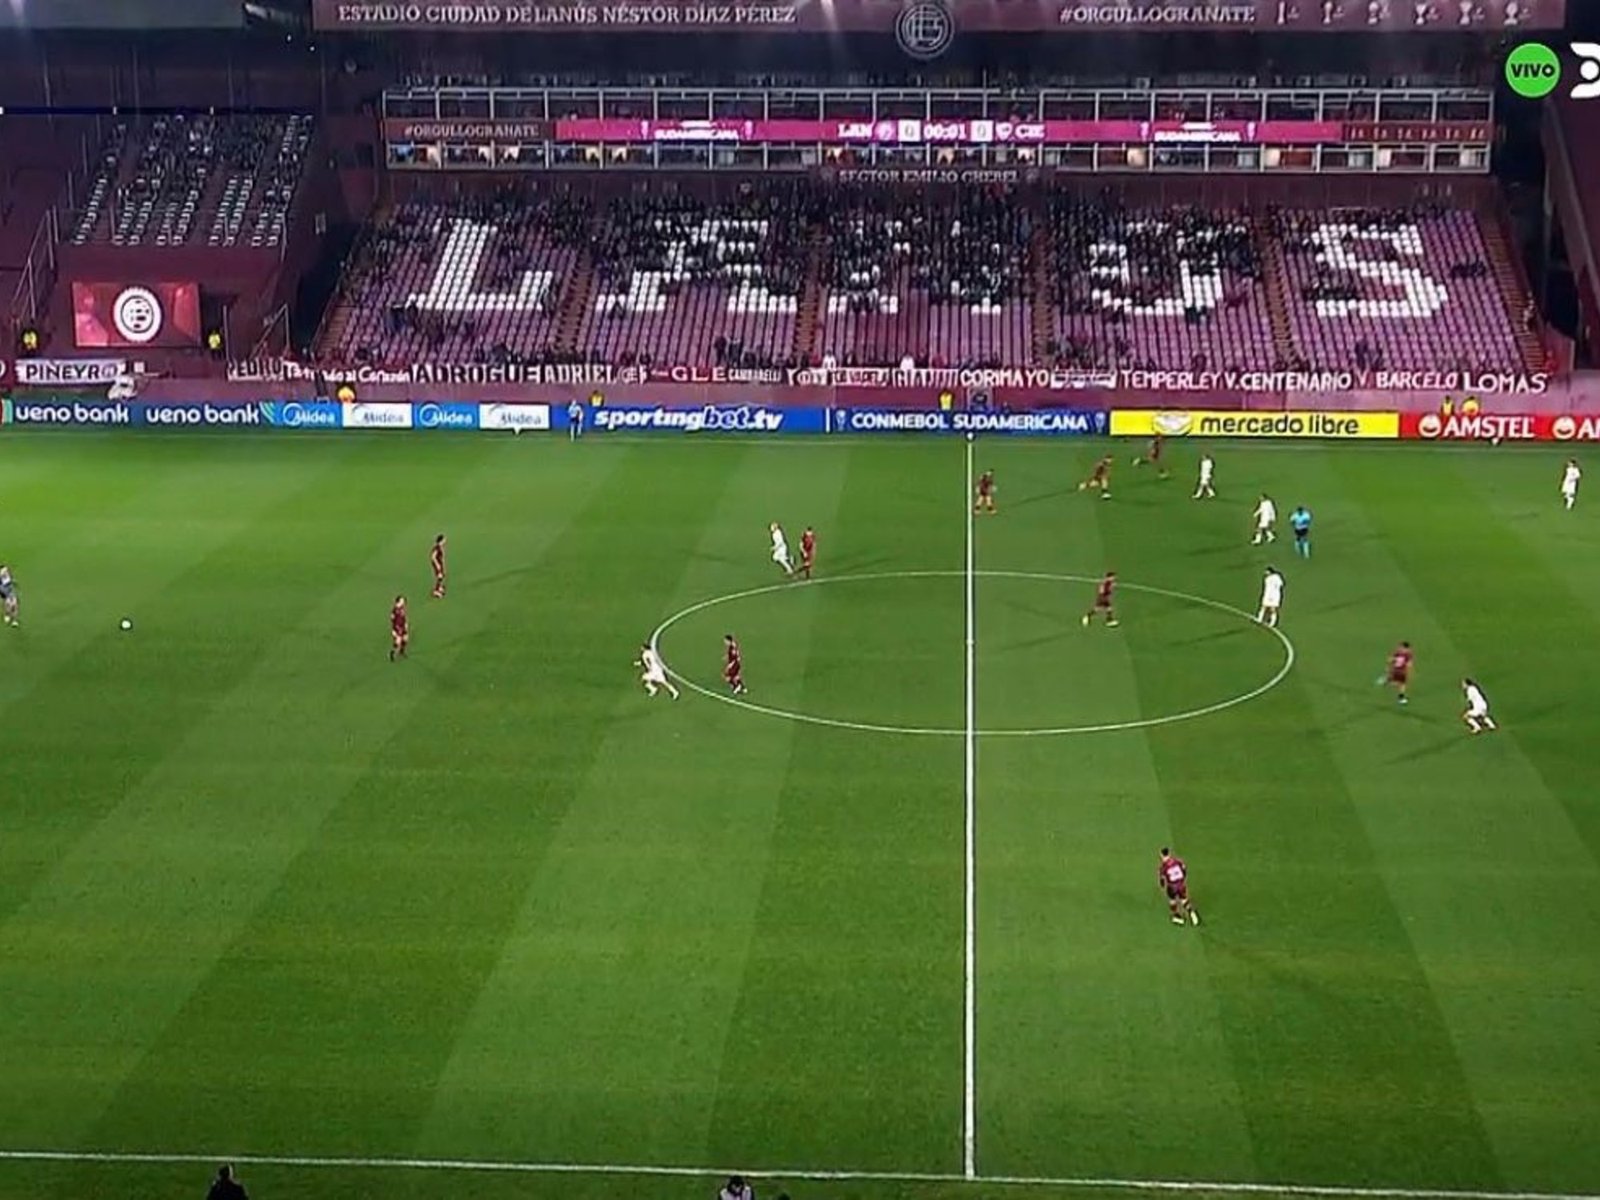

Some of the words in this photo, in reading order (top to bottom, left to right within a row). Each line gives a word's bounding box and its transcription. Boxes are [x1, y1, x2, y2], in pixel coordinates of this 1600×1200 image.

[338, 6, 421, 22] ESTADIO
[426, 8, 501, 23] CIUDAD
[506, 7, 533, 23] DE
[535, 4, 598, 23] LANÚS
[602, 4, 680, 23] NÉSTOR
[735, 4, 796, 23] PÉREZ
[1059, 6, 1255, 24] #ORGULLOGRANATE
[404, 124, 539, 138] #ORGULLOGRANATE
[839, 170, 900, 183] SECTOR
[1121, 370, 1221, 389] TEMPERLEY
[1463, 372, 1546, 393] LOMAS
[15, 406, 72, 423] ueno
[74, 402, 130, 423] bank
[145, 407, 201, 424] ueno
[204, 403, 260, 424] bank
[294, 411, 335, 424] Midea
[362, 411, 404, 424] Midea
[431, 411, 473, 425] Midea
[500, 412, 542, 425] Midea
[593, 407, 783, 432] sportingbet.tv
[851, 412, 949, 429] CONMEBOL
[953, 412, 1089, 430] SUDAMERICANA
[1201, 415, 1304, 434] mercado
[1307, 415, 1360, 435] libre
[1446, 416, 1535, 438] AMSTEL
